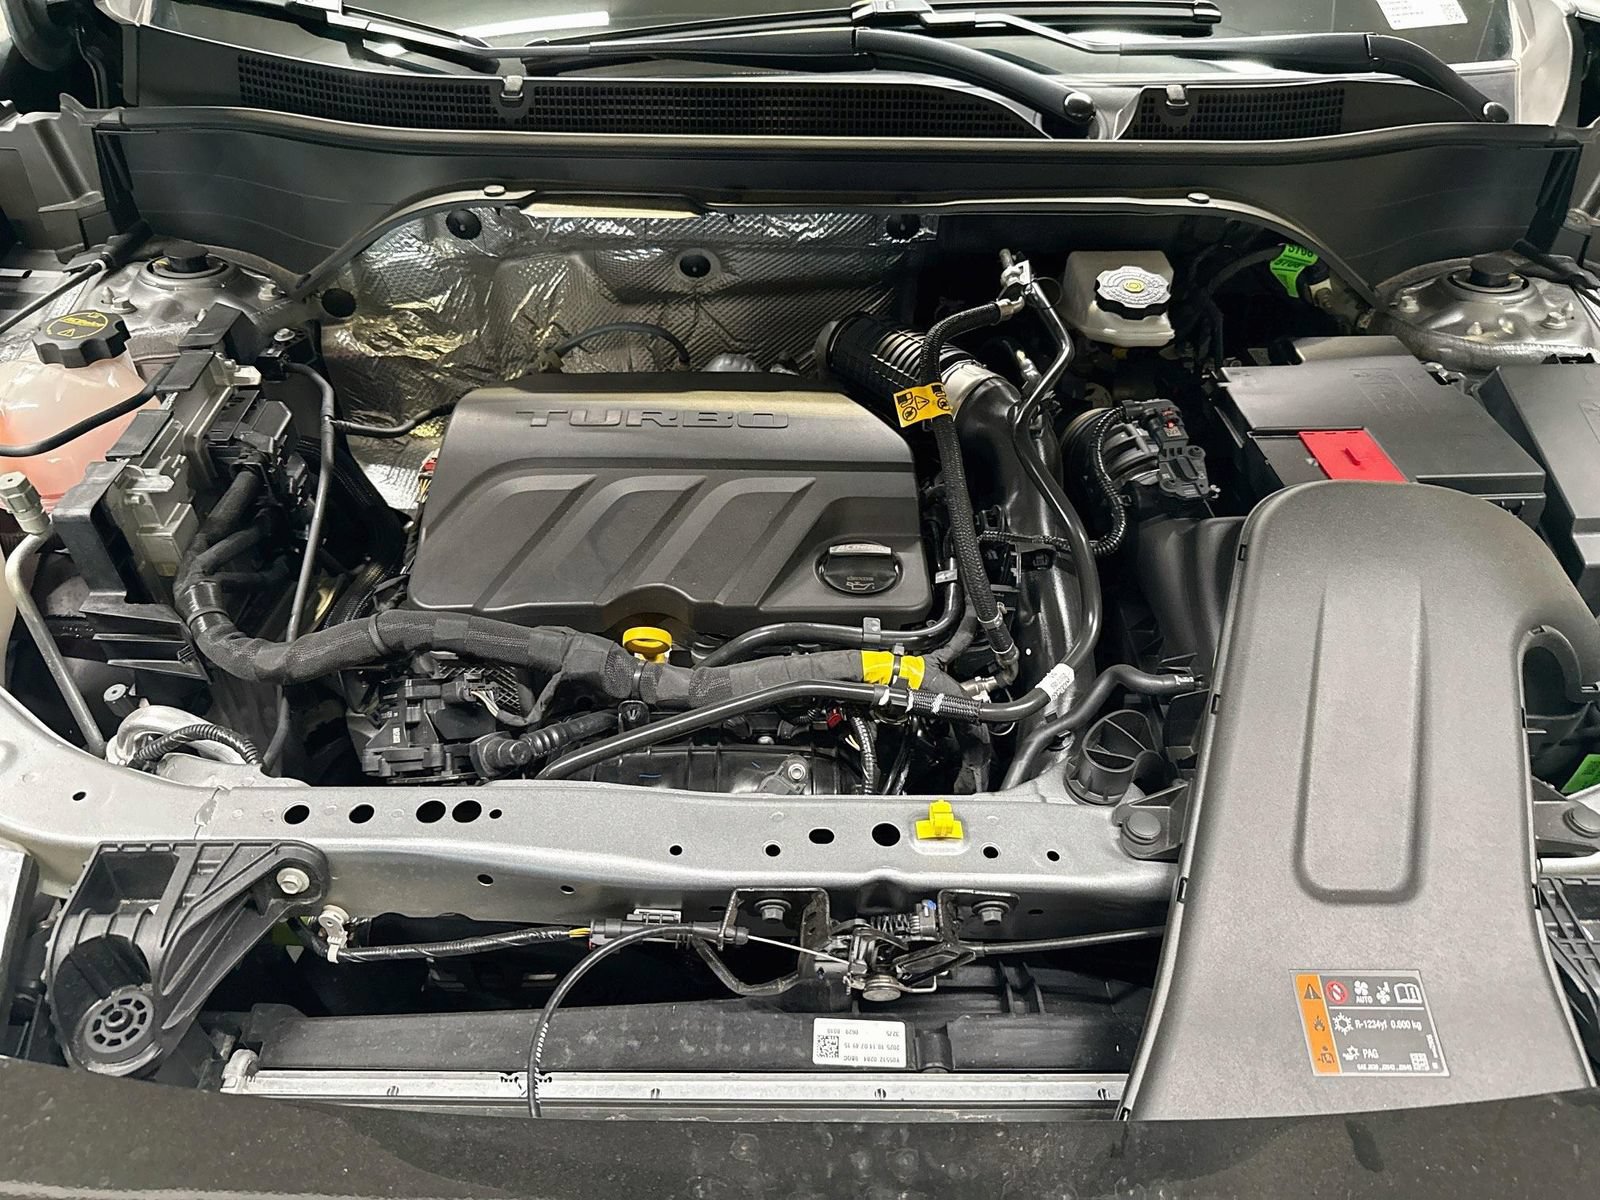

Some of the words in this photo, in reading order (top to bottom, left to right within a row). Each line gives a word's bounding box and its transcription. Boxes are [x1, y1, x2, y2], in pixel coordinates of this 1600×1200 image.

[515, 409, 789, 428] TURBO
[1356, 996, 1373, 1004] AUTO
[1411, 1019, 1422, 1031] kg
[1362, 1048, 1379, 1059] PAG
